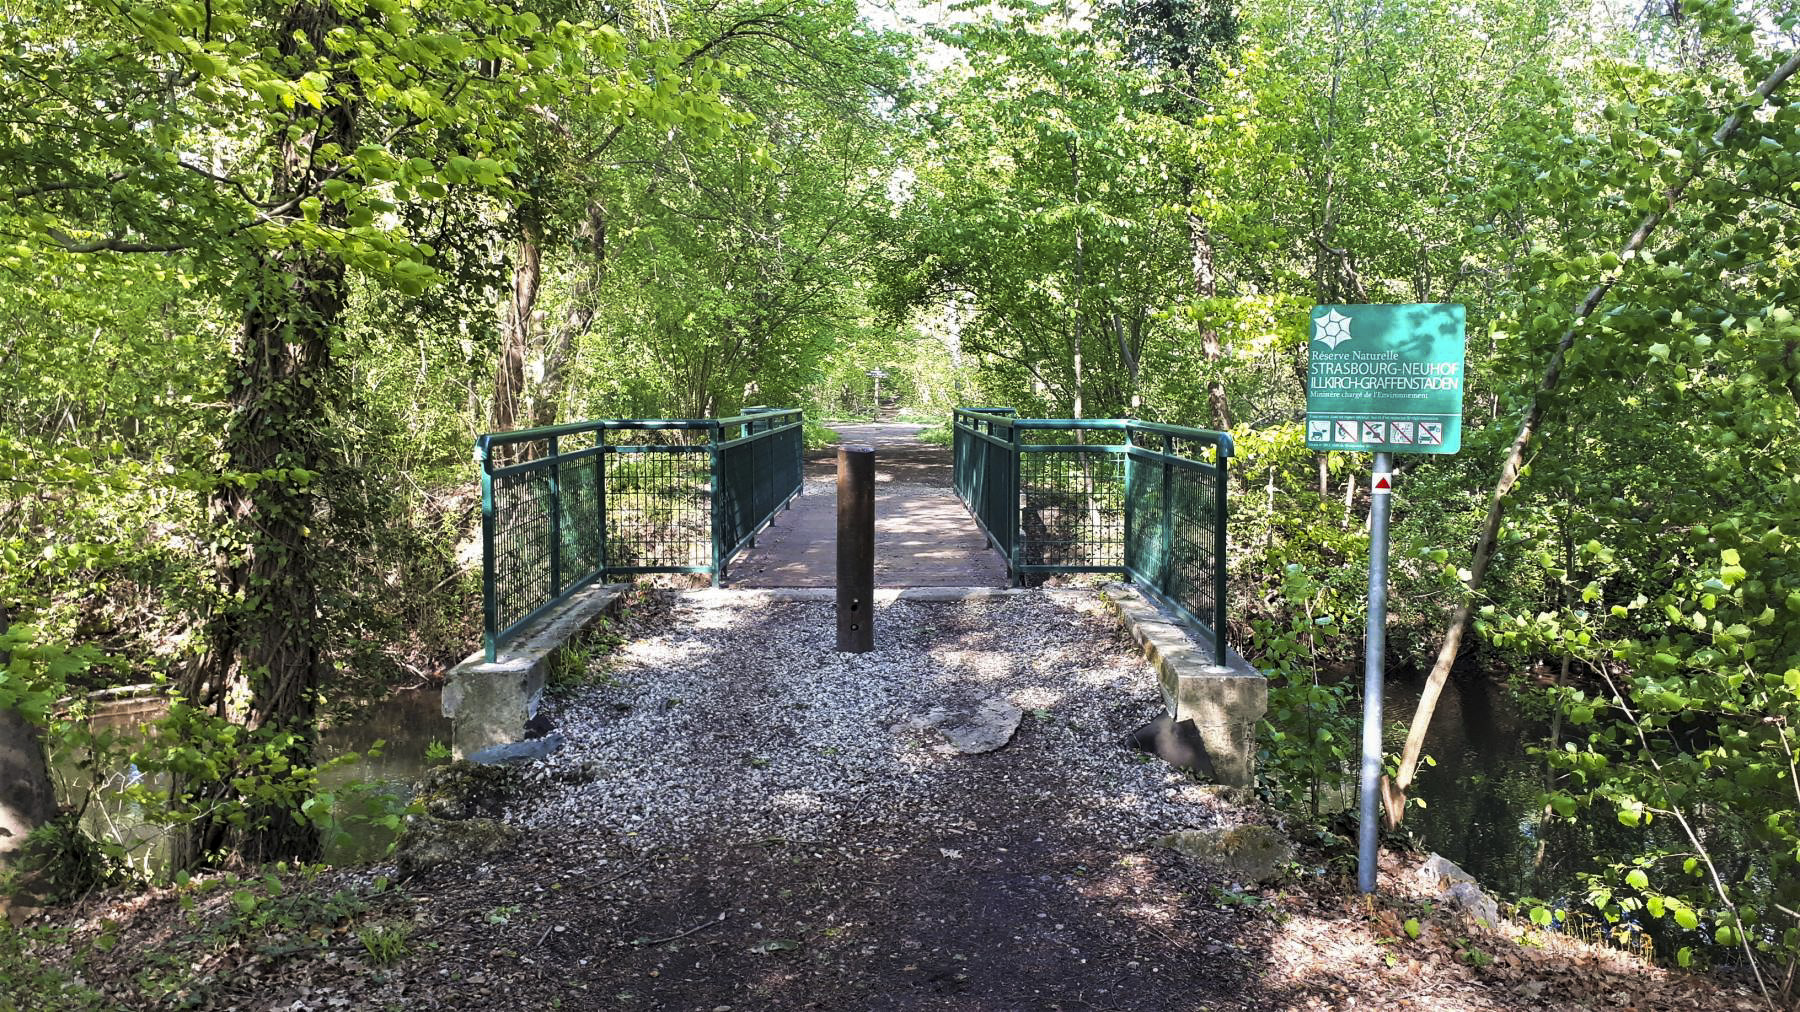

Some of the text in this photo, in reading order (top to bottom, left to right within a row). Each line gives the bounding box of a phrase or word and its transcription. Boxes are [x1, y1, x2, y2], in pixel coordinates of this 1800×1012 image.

[1311, 350, 1399, 361] Réserve Naturelle
[1311, 362, 1458, 375] STRASBOURG-NEUHOF
[1311, 376, 1459, 390] ILLKIRCH-GRAFFENSTADEN
[1341, 391, 1363, 399] chargé
